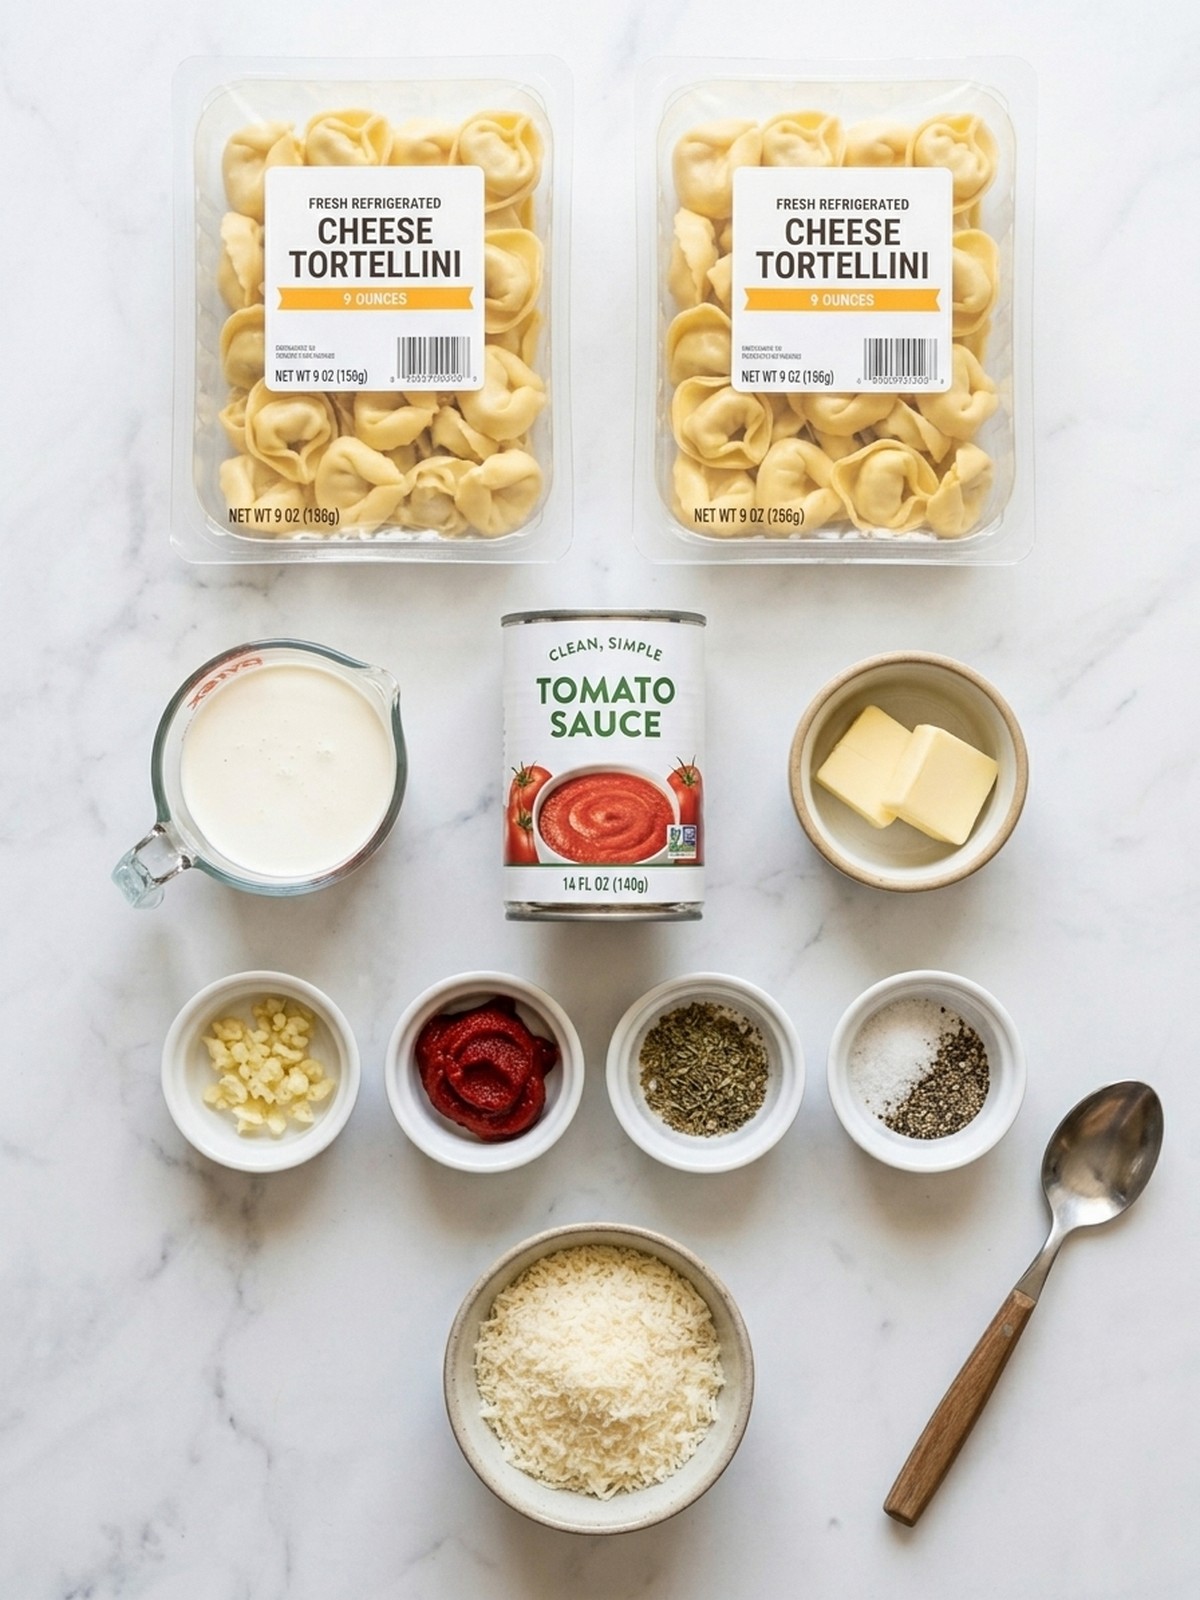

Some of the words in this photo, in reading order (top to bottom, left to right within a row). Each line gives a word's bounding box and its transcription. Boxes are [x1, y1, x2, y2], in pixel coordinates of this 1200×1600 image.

[309, 197, 348, 209] FRESH
[352, 197, 441, 209] REFRIGERATED
[776, 198, 815, 210] FRESH
[819, 198, 909, 210] REFRIGERATED
[318, 217, 433, 244] CHEESE
[785, 218, 900, 246] CHEESE
[289, 250, 460, 278] TORTELLINI
[756, 251, 928, 279] TORTELLINI
[344, 293, 352, 305] 9
[356, 293, 407, 305] OUNCES
[810, 294, 818, 306] 9
[823, 294, 874, 306] OUNCES
[275, 369, 294, 382] NET
[295, 369, 311, 382] WT
[314, 369, 319, 382] 9
[742, 370, 760, 383] NET
[762, 370, 777, 383] WT
[780, 370, 786, 383] 9
[229, 508, 251, 523] NET
[254, 508, 272, 523] WT
[274, 508, 282, 523] 9
[694, 508, 716, 523] NET
[719, 508, 737, 523] WT
[739, 508, 747, 523] 9
[750, 508, 764, 523] OZ
[548, 637, 603, 662] CLEAN,
[608, 637, 663, 662] SIMPLE
[536, 676, 676, 705] TOMATO
[550, 711, 661, 738] SAUCE
[563, 877, 575, 891] 14
[579, 877, 592, 891] FL
[595, 877, 609, 891] OZ
[612, 876, 648, 893] (140g)
